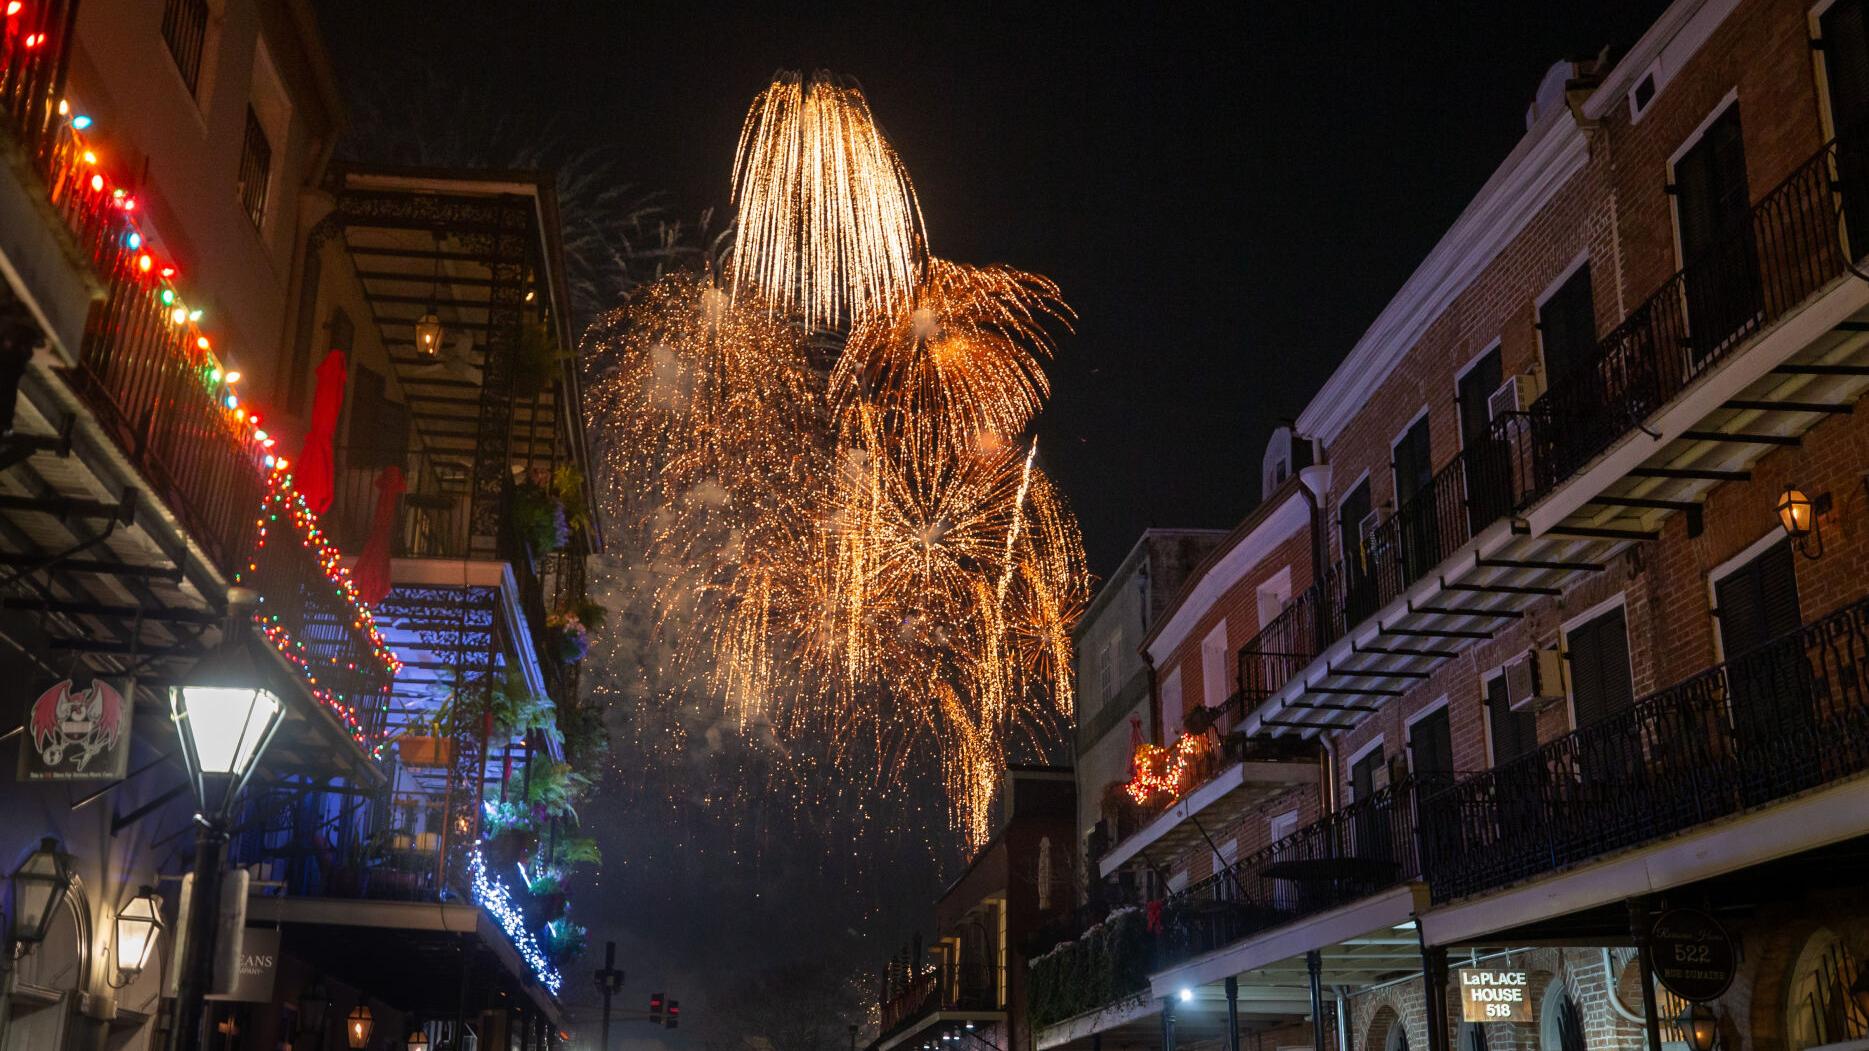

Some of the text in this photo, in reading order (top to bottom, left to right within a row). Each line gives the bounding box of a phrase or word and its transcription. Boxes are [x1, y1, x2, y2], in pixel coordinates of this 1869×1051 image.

[1674, 943, 1711, 963] 522
[1462, 972, 1527, 985] LaPLACE
[1471, 988, 1523, 1002] HOUSE
[1486, 1004, 1511, 1018] 518
